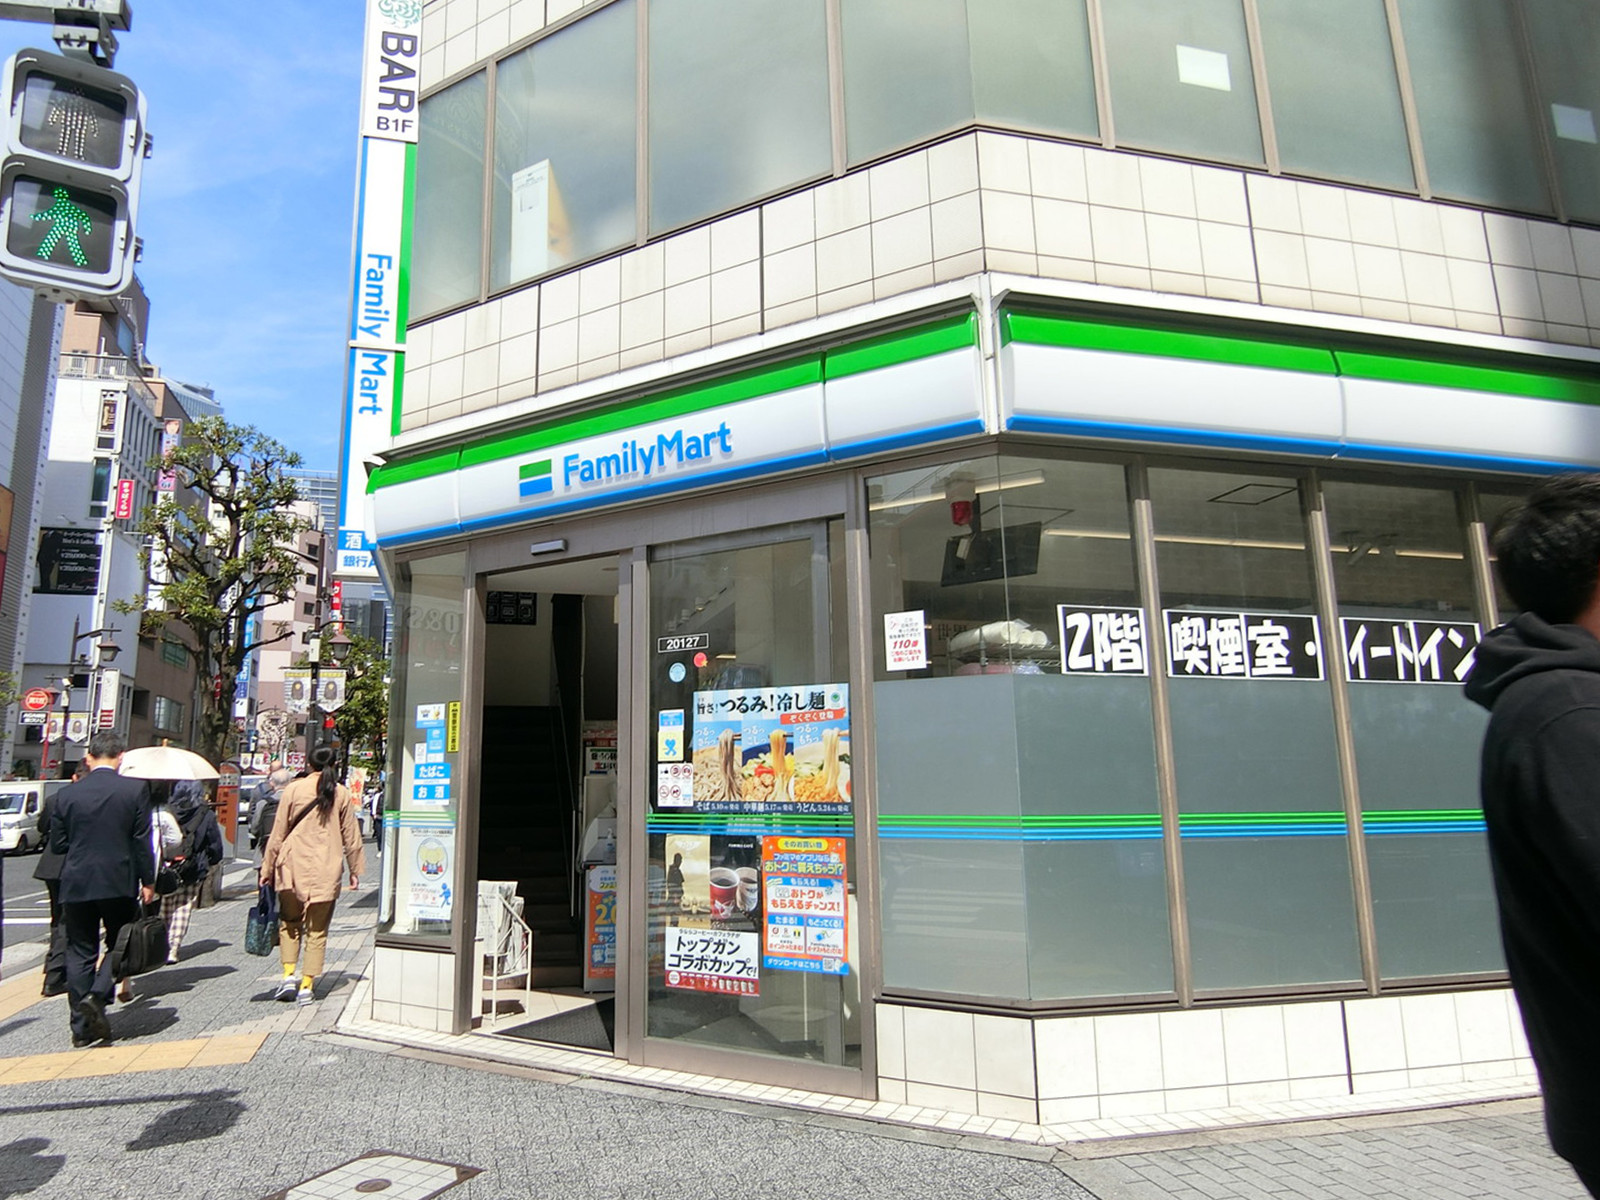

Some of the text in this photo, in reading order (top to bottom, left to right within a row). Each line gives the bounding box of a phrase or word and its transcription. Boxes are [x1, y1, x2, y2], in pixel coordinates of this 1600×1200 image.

[377, 31, 418, 113] BAR
[376, 116, 414, 133] B1F
[358, 253, 393, 415] Family Mart
[563, 422, 732, 487] FamilyMart
[345, 532, 363, 550] 酒
[666, 637, 700, 650] 20127
[1066, 612, 1144, 671] 2階
[1349, 624, 1477, 681] イートイン
[418, 765, 445, 778] たばこ
[417, 786, 445, 799] お酒
[771, 899, 840, 912] もらえるチャンス!
[677, 936, 741, 956] トップガン
